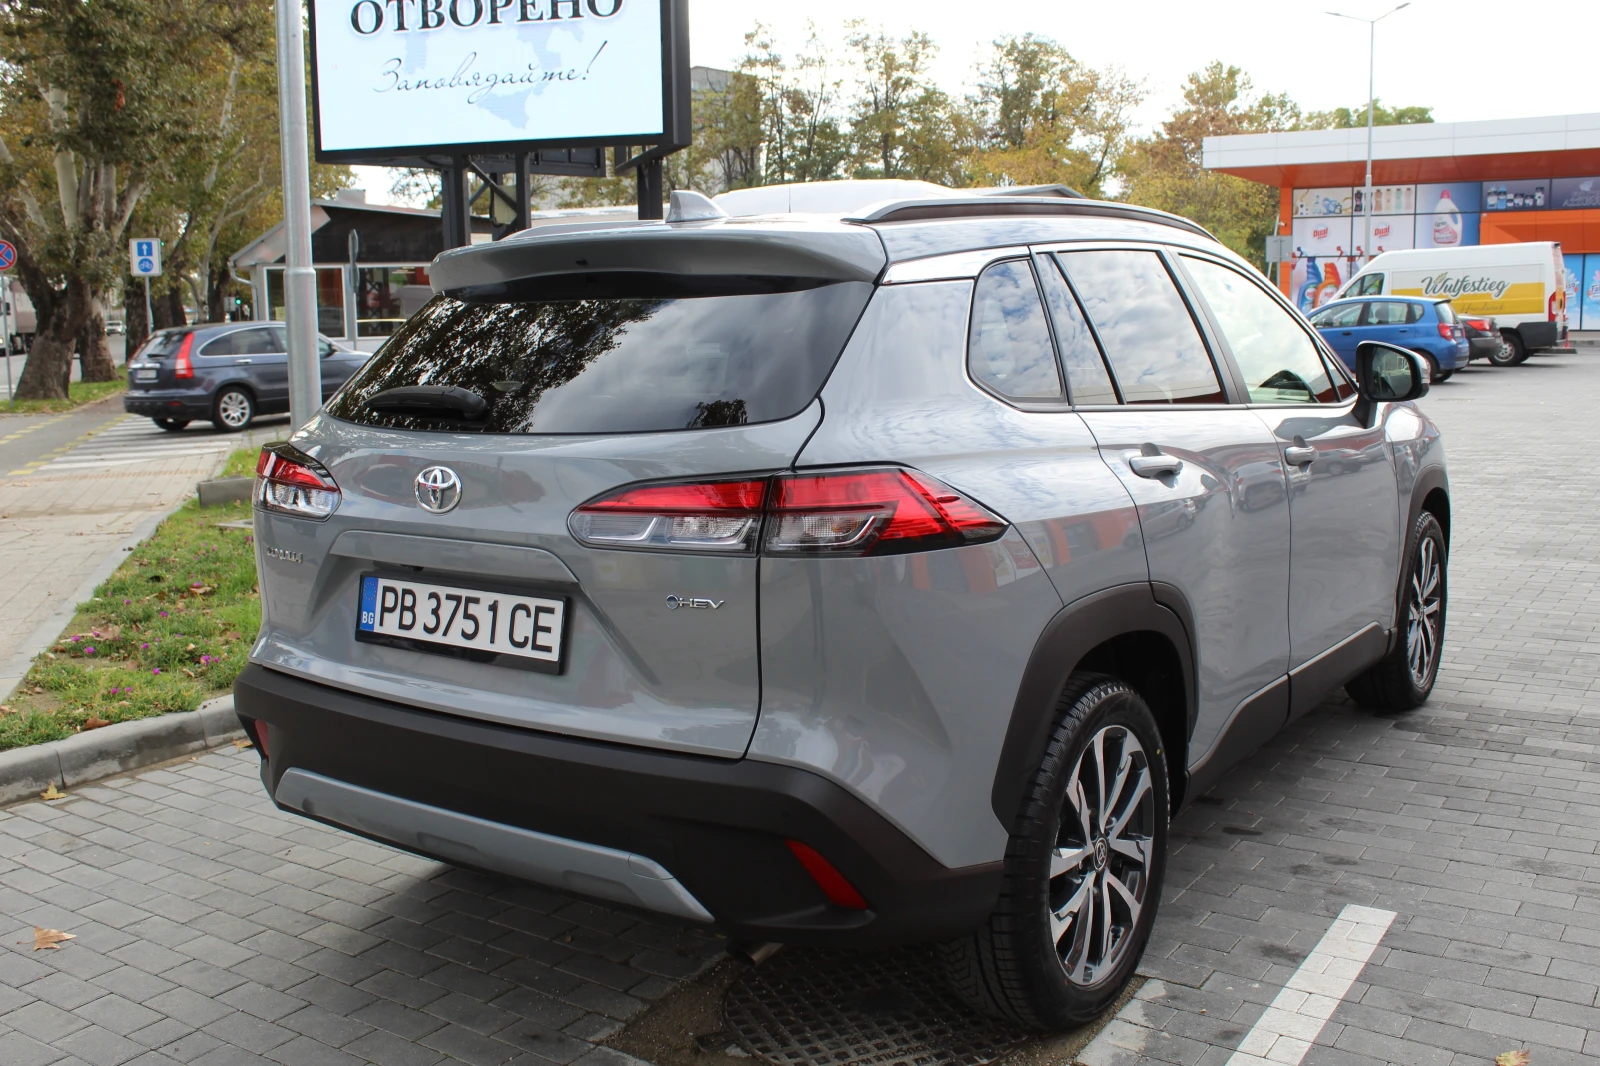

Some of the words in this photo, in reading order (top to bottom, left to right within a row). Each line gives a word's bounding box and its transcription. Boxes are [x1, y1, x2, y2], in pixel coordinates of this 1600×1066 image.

[350, 0, 624, 35] ОТВОРЕНО
[372, 40, 608, 104] Заповядайте!
[1313, 227, 1329, 238] Dual
[1374, 225, 1390, 236] Dual
[1421, 274, 1509, 298] Wulfestieg
[361, 611, 375, 625] BG
[422, 591, 499, 645] 3751
